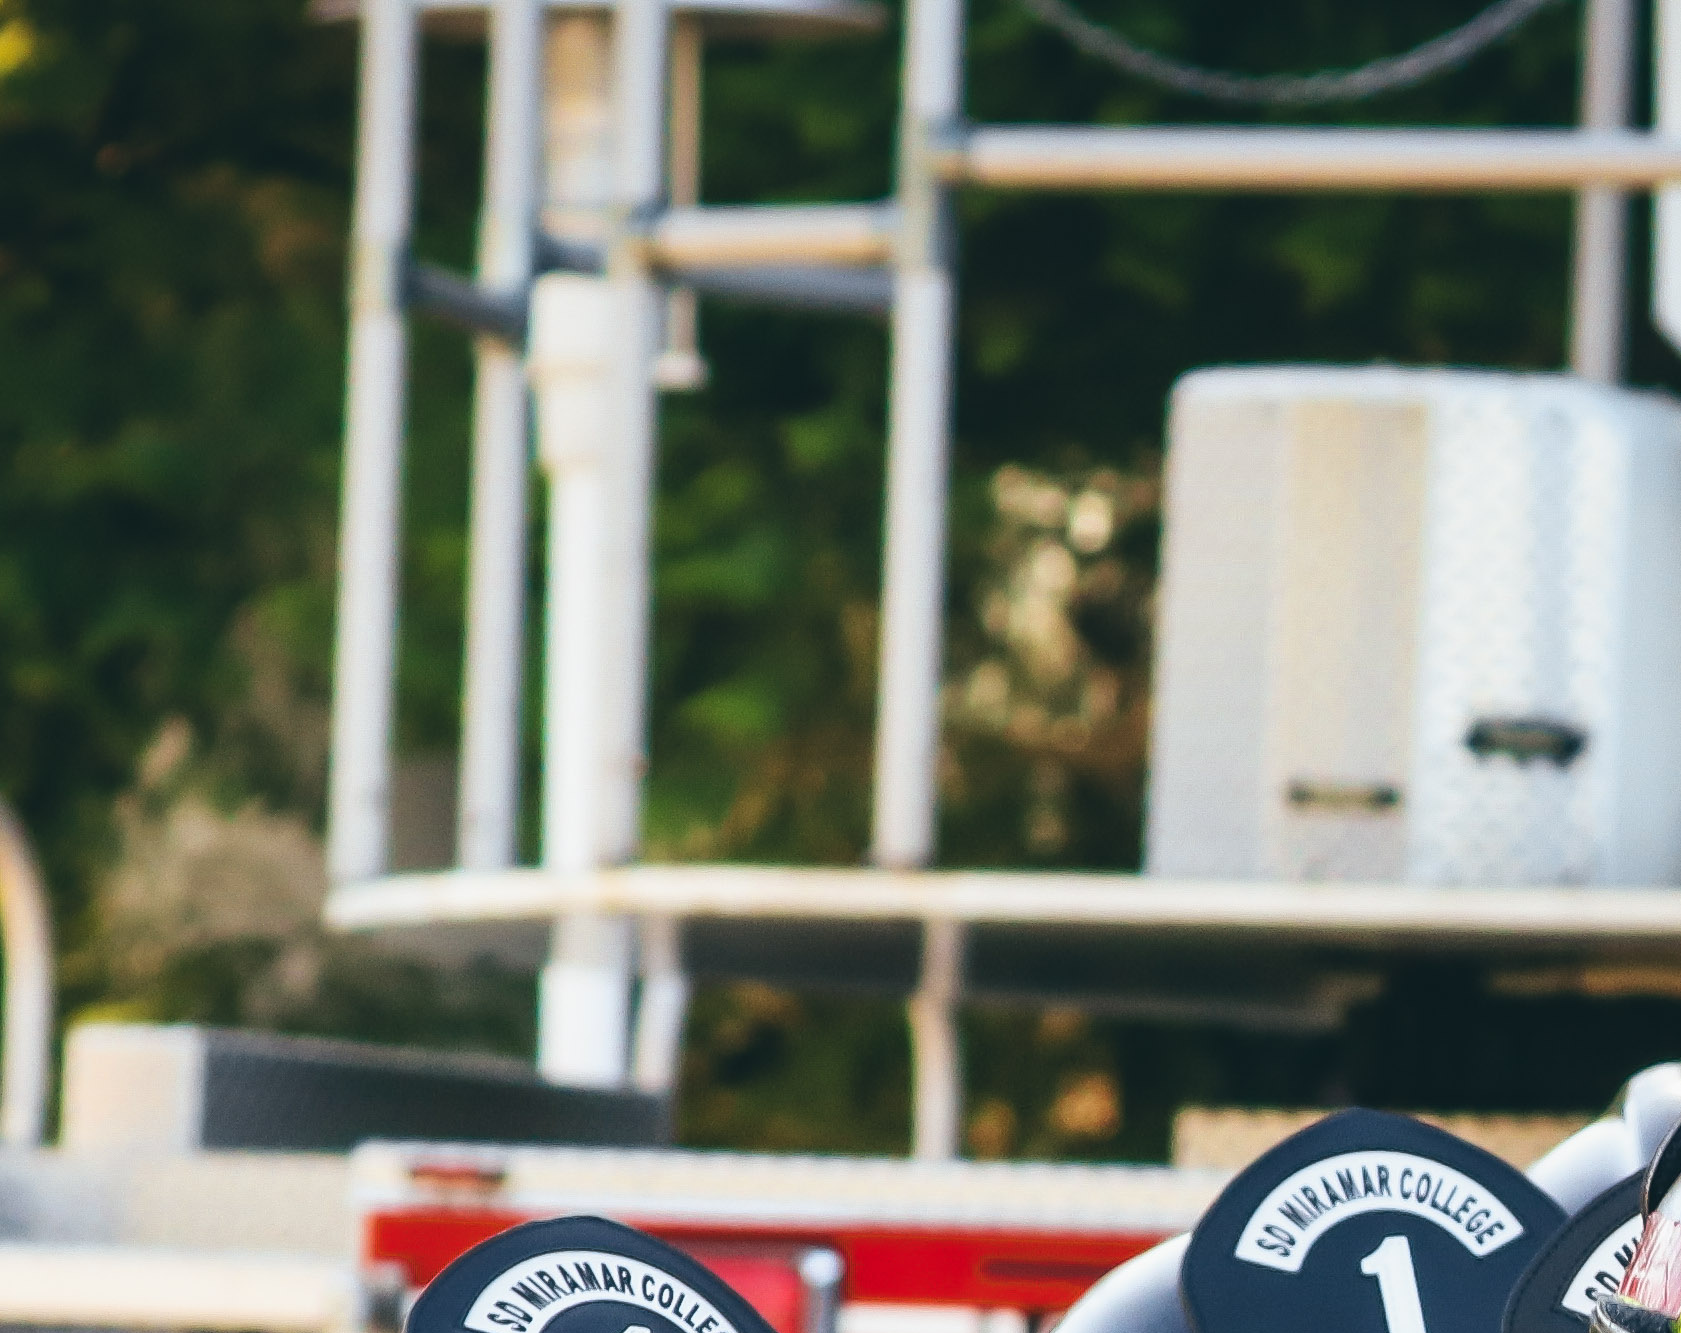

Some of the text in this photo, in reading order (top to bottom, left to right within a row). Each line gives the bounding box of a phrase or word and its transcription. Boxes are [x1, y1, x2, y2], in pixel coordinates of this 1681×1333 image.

[1256, 1164, 1506, 1257] SD MIRAMAR COLLEGE
[487, 1300, 533, 1333] SD
[511, 1261, 635, 1311] MIRAMAR
